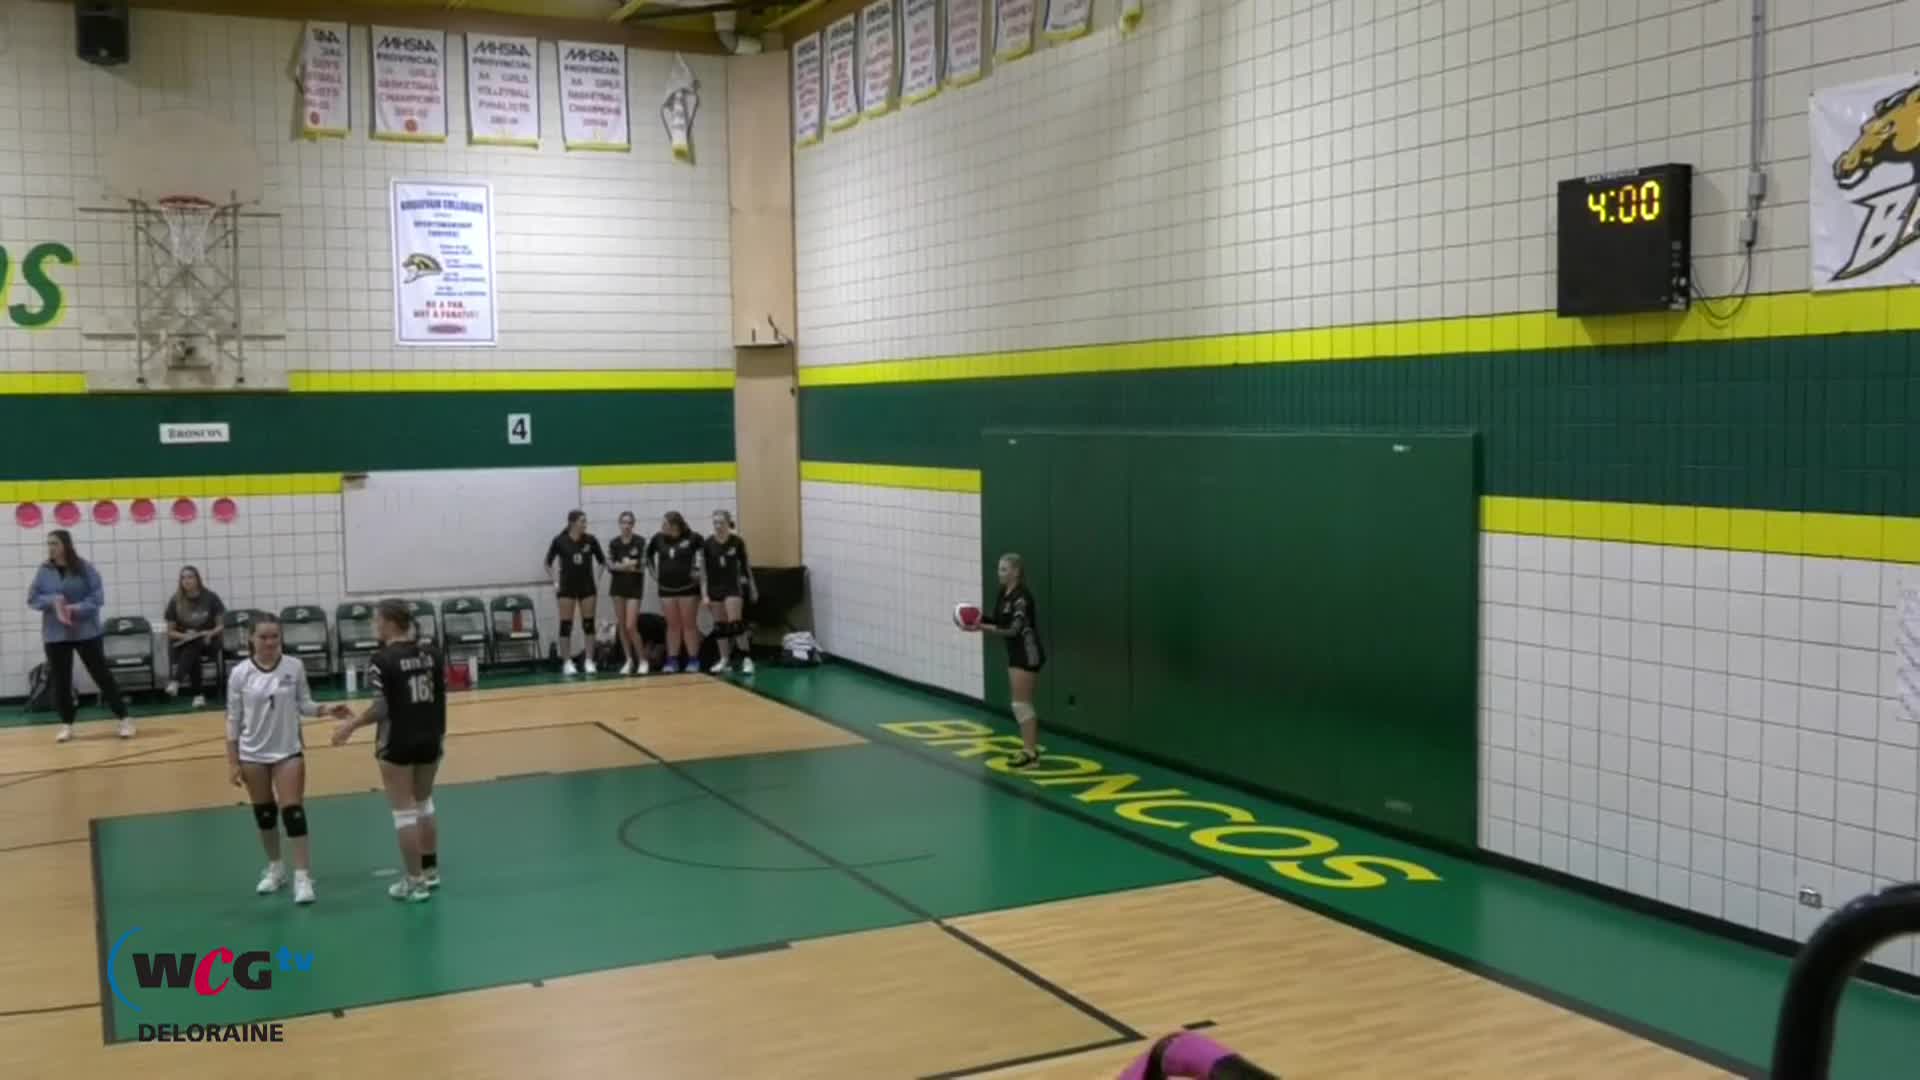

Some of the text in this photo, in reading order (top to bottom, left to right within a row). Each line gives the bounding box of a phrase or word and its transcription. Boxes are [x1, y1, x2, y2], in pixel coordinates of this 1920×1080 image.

[377, 36, 438, 53] MHSAA
[472, 40, 531, 57] MHSAA
[376, 52, 438, 66] PROVINCIAL
[472, 56, 531, 70] PROVINCIAL
[564, 48, 620, 63] MHSAA
[563, 63, 621, 76] PROVINCIAL
[1588, 180, 1660, 224] 4:00
[167, 427, 225, 441] BRONCOS
[512, 417, 529, 440] 4
[877, 718, 1444, 889] BRONCOS
